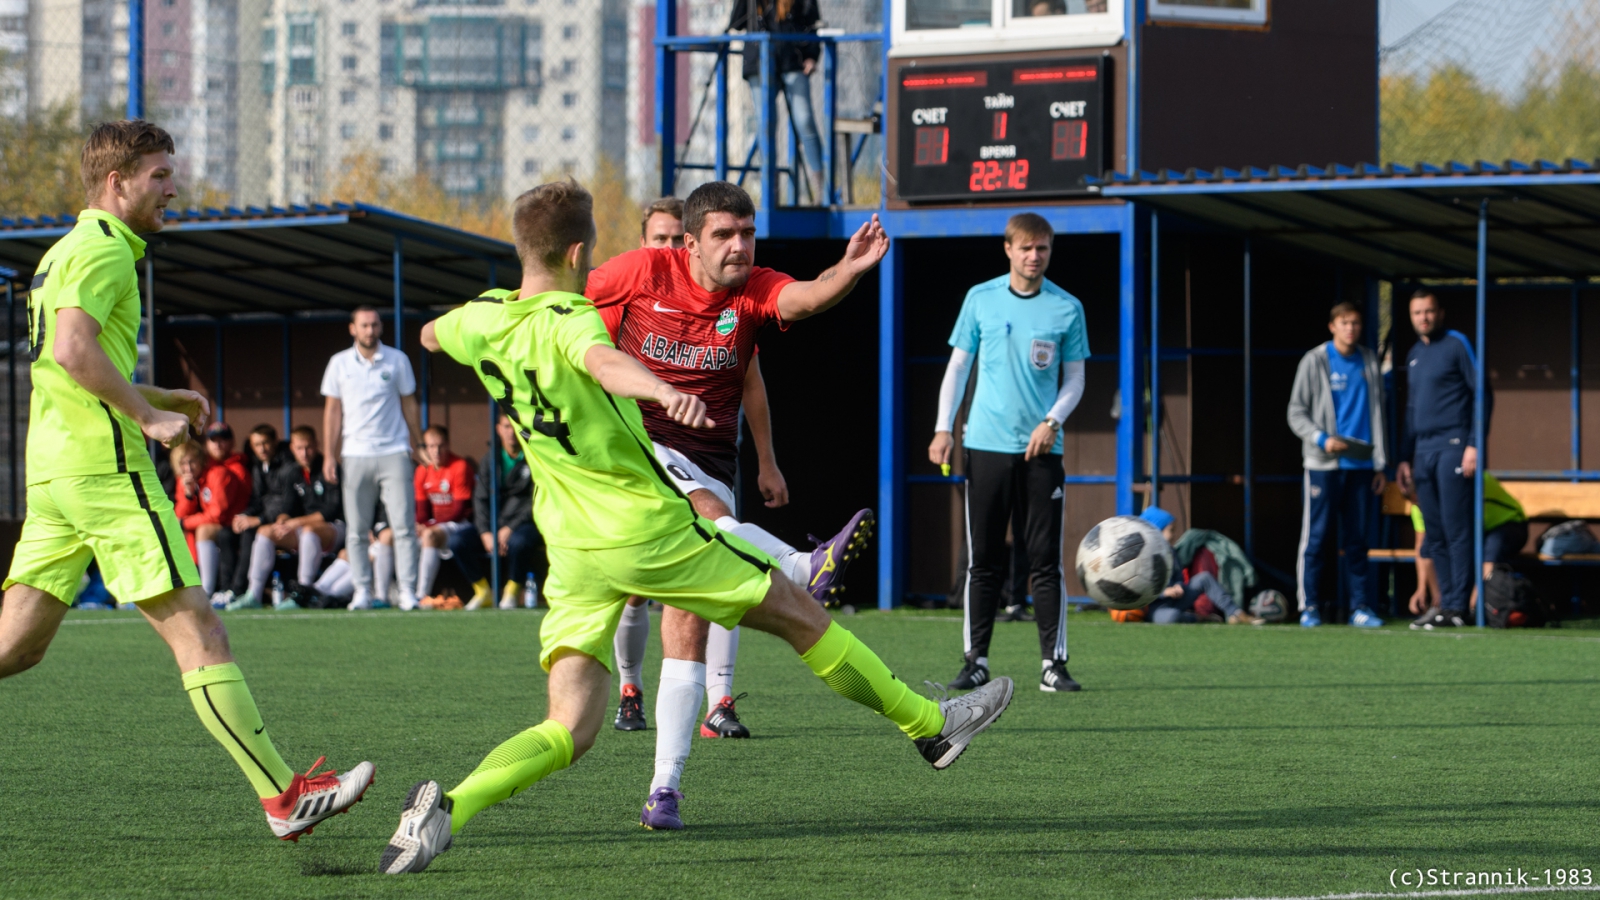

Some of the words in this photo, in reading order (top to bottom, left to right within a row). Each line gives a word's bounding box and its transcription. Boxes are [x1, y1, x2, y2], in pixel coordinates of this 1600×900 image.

[983, 93, 1015, 109] ТАЙМ
[1050, 101, 1087, 118] СЧЕТ
[912, 107, 948, 125] СЧЕТ
[980, 145, 1016, 159] ВРЕМЯ
[969, 159, 1029, 191] 22:12
[641, 332, 739, 371] АВАНГАРД
